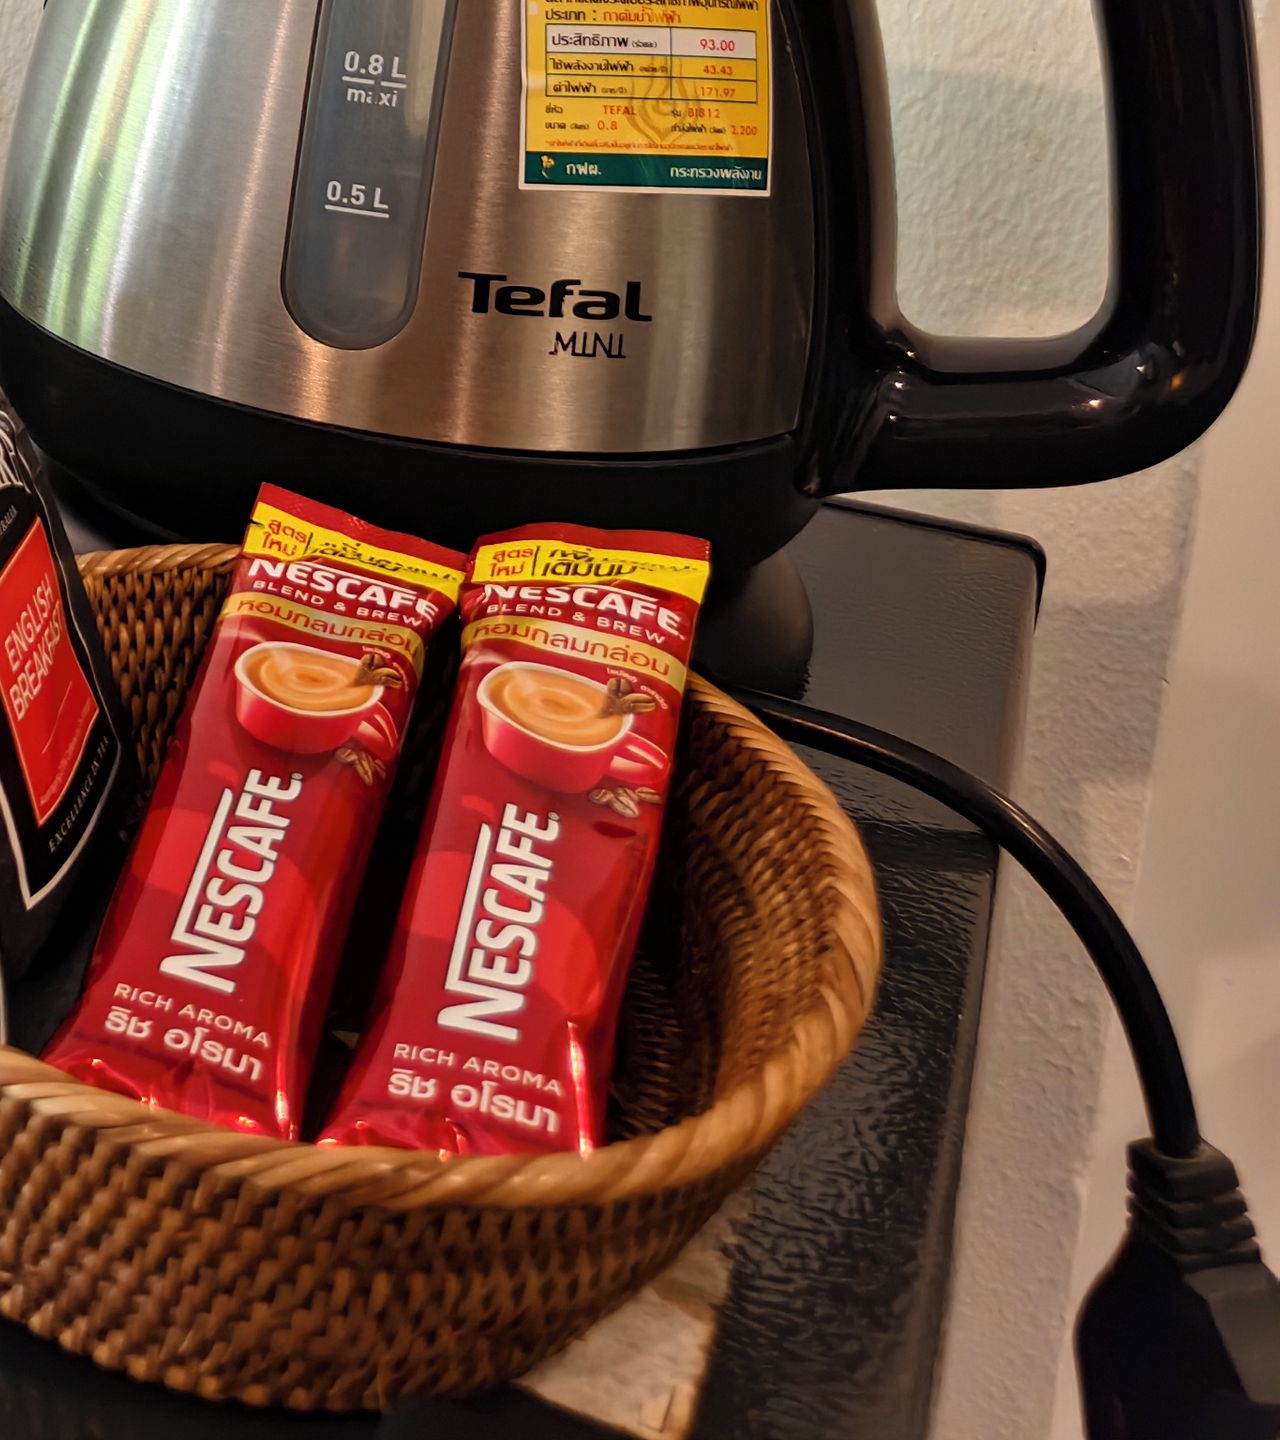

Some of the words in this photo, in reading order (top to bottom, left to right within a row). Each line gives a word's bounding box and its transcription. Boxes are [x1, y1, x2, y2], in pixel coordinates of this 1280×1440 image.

[551, 32, 629, 48] ประสิทธิภาพ
[699, 38, 736, 51] 93.00
[344, 50, 385, 76] 0.8
[391, 55, 407, 79] L
[703, 64, 733, 76] 43.43
[700, 86, 736, 98] 171.97
[603, 104, 637, 116] TEFAL
[597, 120, 618, 131] 0.8
[326, 180, 365, 206] 0.5
[373, 185, 390, 210] L
[458, 271, 653, 323] Tefal
[548, 330, 628, 359] MINI
[267, 518, 308, 544] สูตร
[492, 547, 534, 563] สูตร
[252, 579, 326, 606] BLEND
[333, 601, 346, 613] &
[356, 607, 423, 627] BREW
[4, 571, 54, 672] ENGLISH
[486, 603, 563, 617] BLEND
[572, 611, 586, 622] &
[596, 616, 666, 645] BREW
[9, 600, 65, 721] BREAKFAST
[113, 982, 174, 1012] RICH
[178, 1002, 272, 1050] AROMA
[163, 1026, 264, 1082] อโรมา
[393, 1042, 455, 1067] RICH
[462, 1056, 564, 1097] AROMA
[450, 1082, 559, 1134] อโรมา
